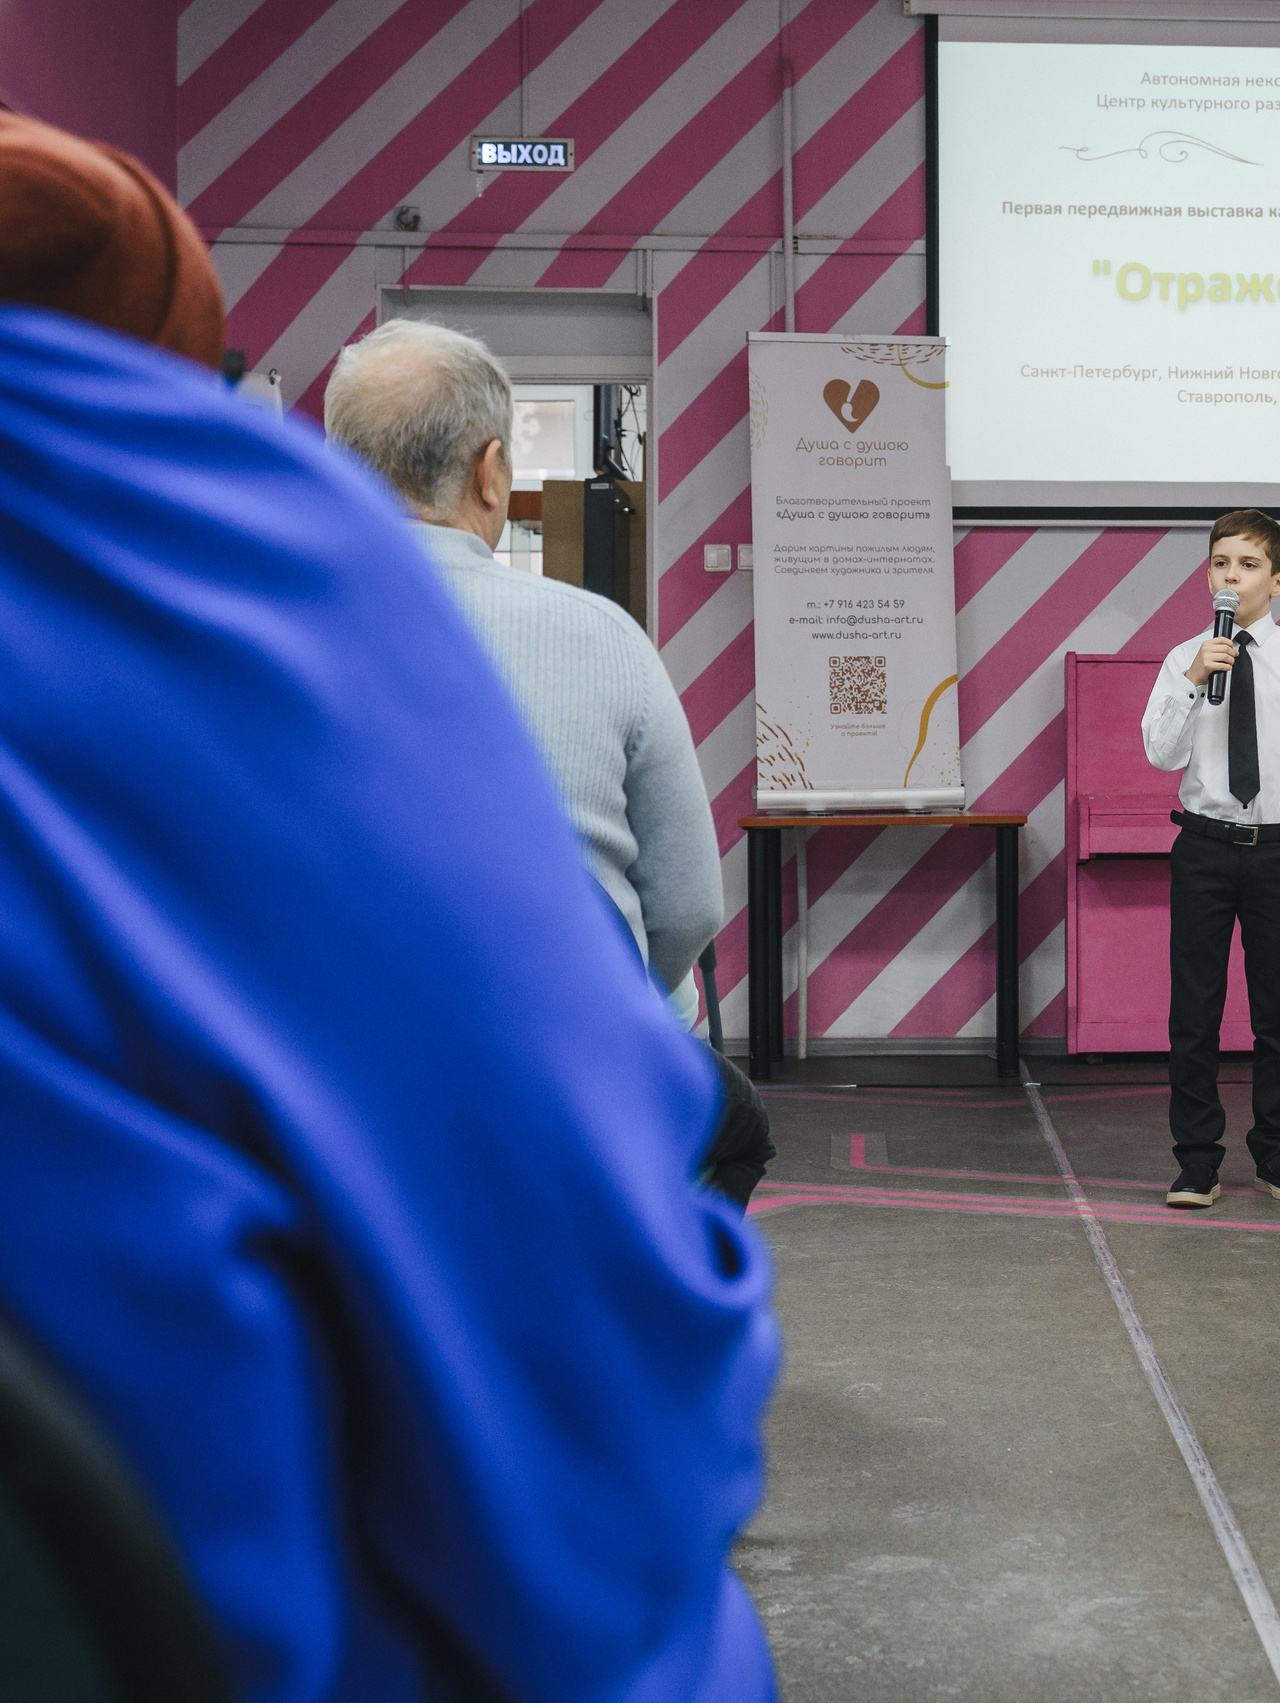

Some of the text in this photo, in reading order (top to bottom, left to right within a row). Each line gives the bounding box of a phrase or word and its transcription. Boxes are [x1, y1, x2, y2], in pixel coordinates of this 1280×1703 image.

[1141, 72, 1240, 86] Автономная
[1097, 94, 1146, 110] Центр
[1151, 99, 1250, 112] культурного
[481, 143, 565, 166] ВЫХОД
[1002, 201, 1062, 217] Первая
[1068, 205, 1182, 218] передвижная
[1188, 207, 1263, 218] выставка
[1020, 364, 1162, 381] Санкт-Петербург,
[1168, 366, 1233, 379] Нижний
[1177, 390, 1277, 406] Ставрополь,
[796, 437, 909, 454] Душа с душою
[819, 457, 887, 469] говорит
[776, 496, 930, 508] Благотворительный проект
[776, 509, 930, 521] «Душа с душою говорит»
[774, 543, 935, 554] Дарим картины пожилым людям,
[773, 556, 934, 565] живущим в домах-интернатах.
[774, 565, 935, 576] Соединяем художника и зрителя.
[824, 599, 834, 608] +7
[837, 600, 853, 609] 916
[856, 600, 874, 609] 423
[878, 599, 890, 608] 54
[893, 599, 905, 608] 59
[789, 615, 923, 626] e-mail: info@dusha-art.ru
[811, 630, 902, 640] www.dusha-art.ru
